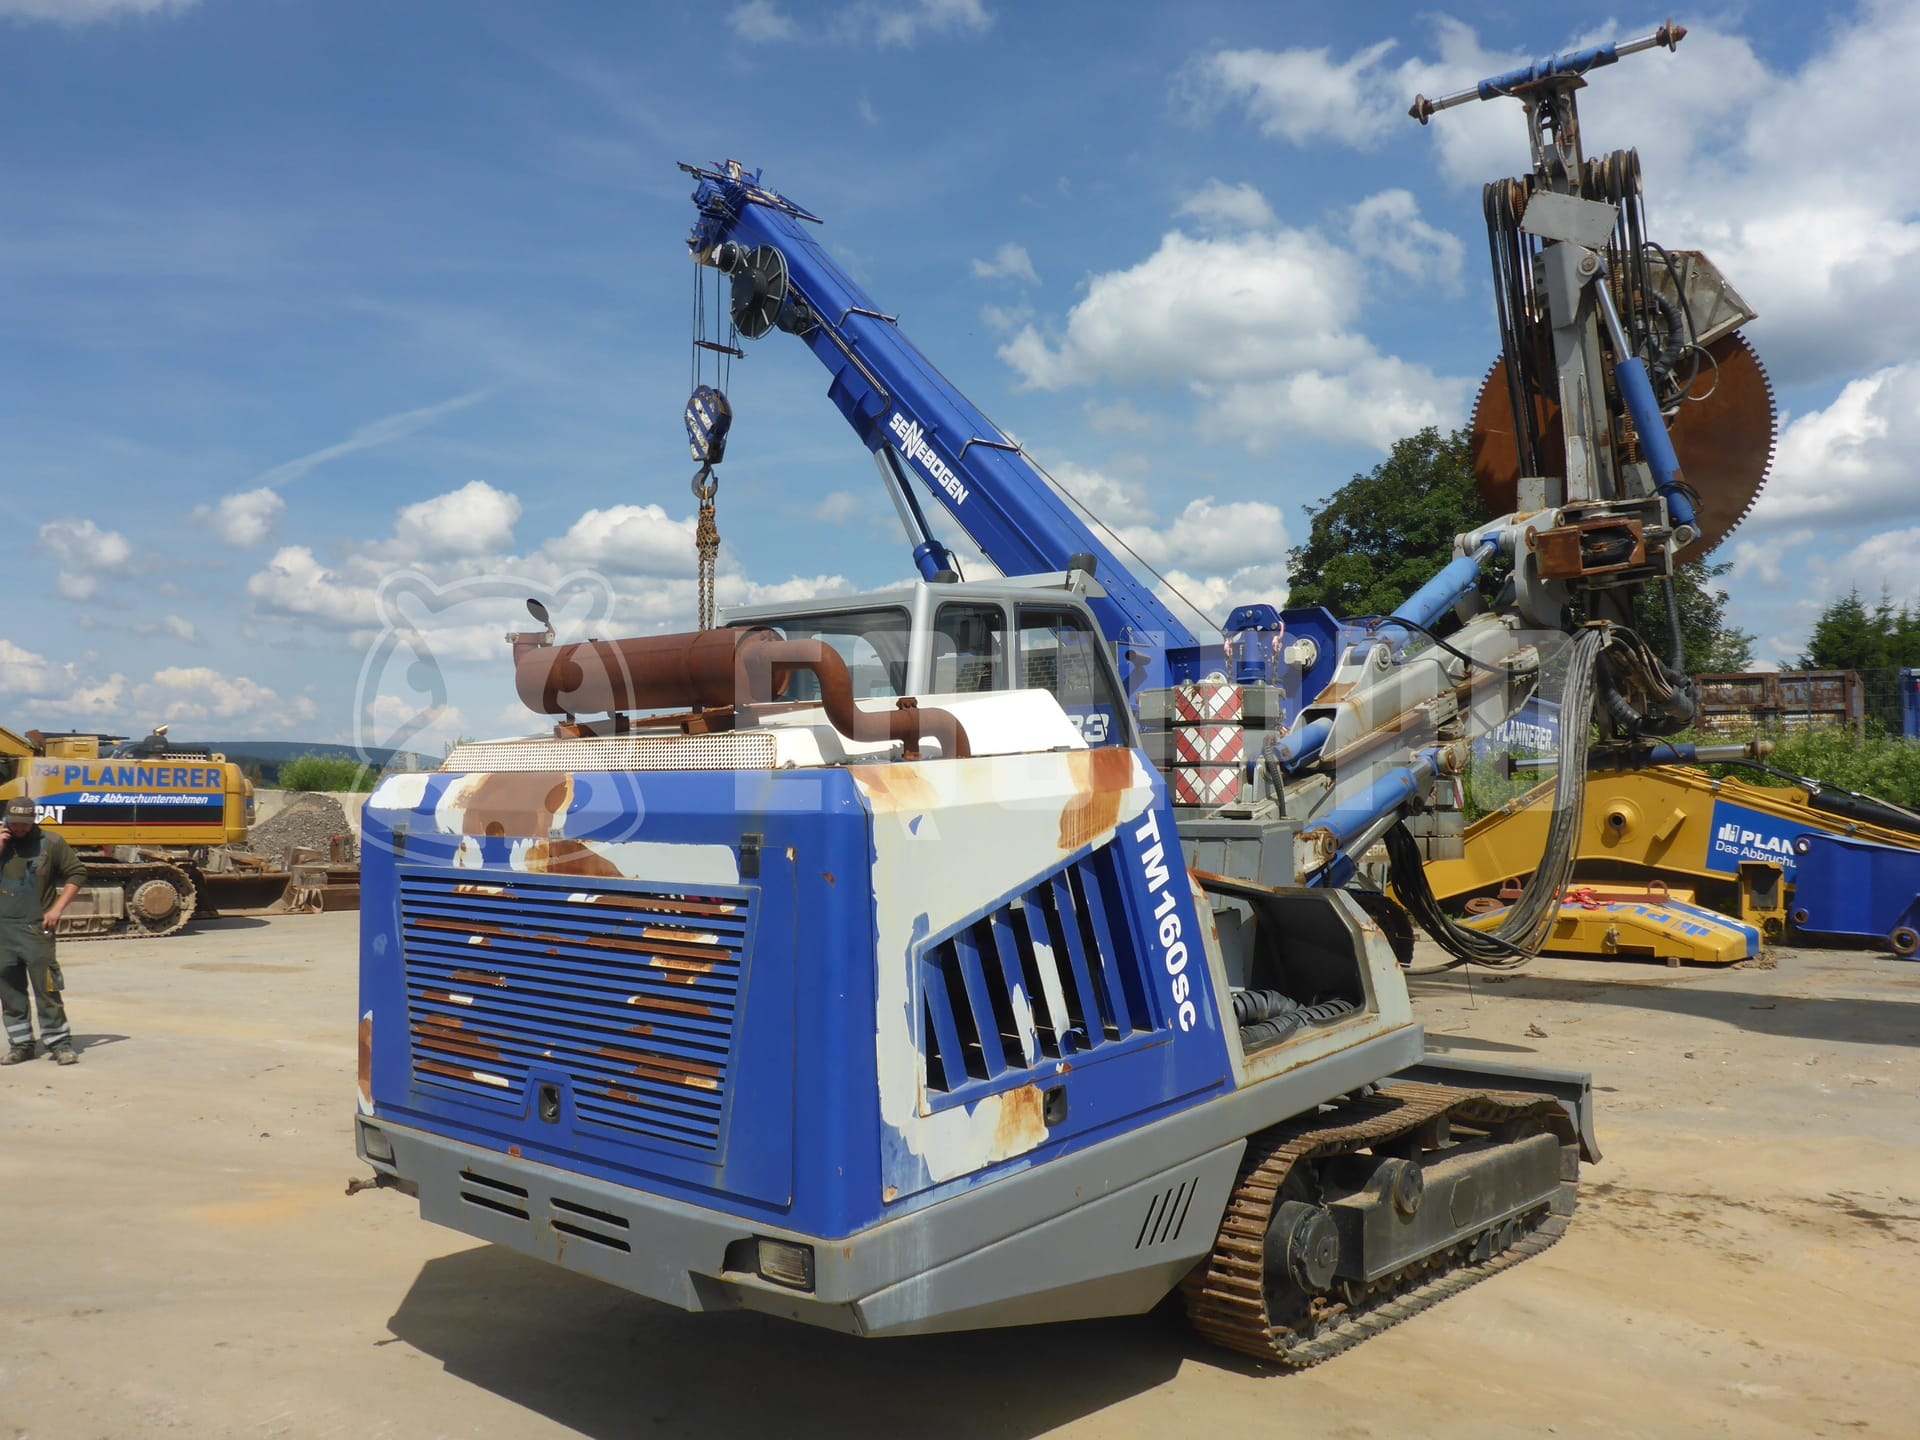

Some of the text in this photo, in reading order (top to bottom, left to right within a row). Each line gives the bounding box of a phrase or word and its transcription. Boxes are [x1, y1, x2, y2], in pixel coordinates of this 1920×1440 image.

[889, 412, 969, 505] SENNEBOGEN
[35, 765, 59, 777] 734
[64, 765, 222, 788] PLANNERER
[79, 792, 209, 805] Das Abbruchunternehmen
[34, 805, 66, 824] CAT
[1715, 840, 1739, 855] Das
